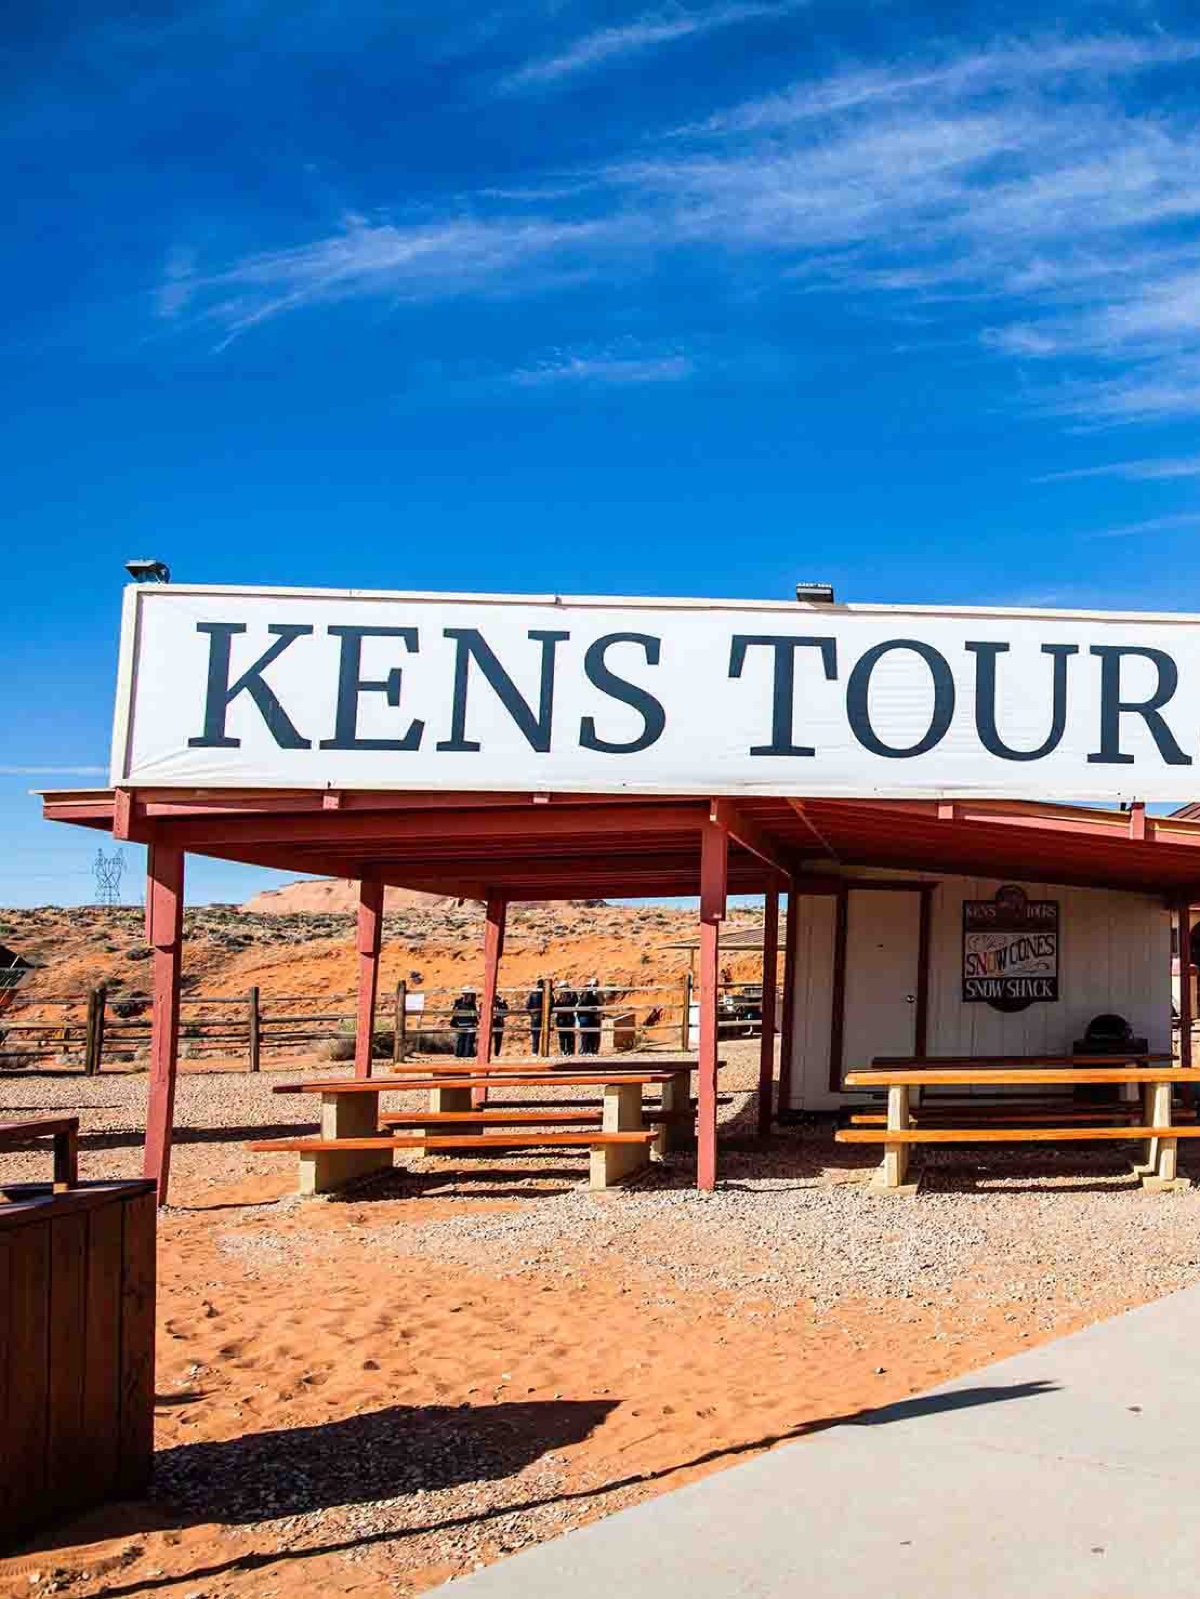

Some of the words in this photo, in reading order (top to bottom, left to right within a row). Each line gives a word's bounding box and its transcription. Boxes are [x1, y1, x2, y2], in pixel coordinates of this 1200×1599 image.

[187, 621, 667, 754] KENS
[966, 946, 1008, 976] SNOW
[1009, 934, 1056, 965] CONES
[966, 979, 1005, 998] SNOW
[1006, 979, 1054, 998] SHACK
